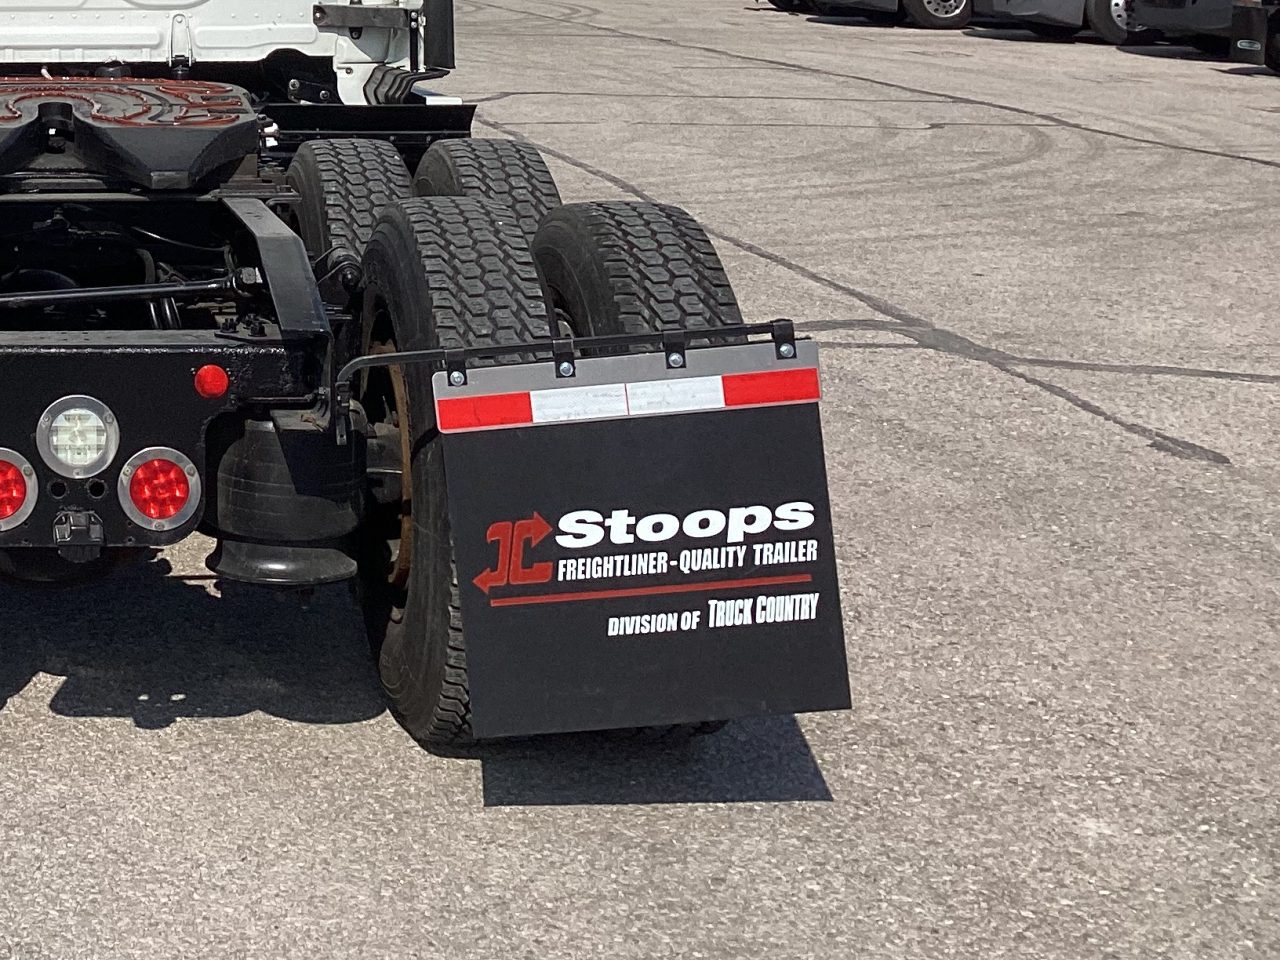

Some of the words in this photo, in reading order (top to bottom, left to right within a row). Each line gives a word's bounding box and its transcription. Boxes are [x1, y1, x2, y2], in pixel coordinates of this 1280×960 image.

[554, 501, 815, 549] Stoops
[752, 539, 818, 566] TRAILER
[607, 612, 679, 637] DIVISION
[680, 610, 701, 631] OF
[707, 597, 754, 628] TRUCK
[755, 592, 820, 624] COUNTRY
